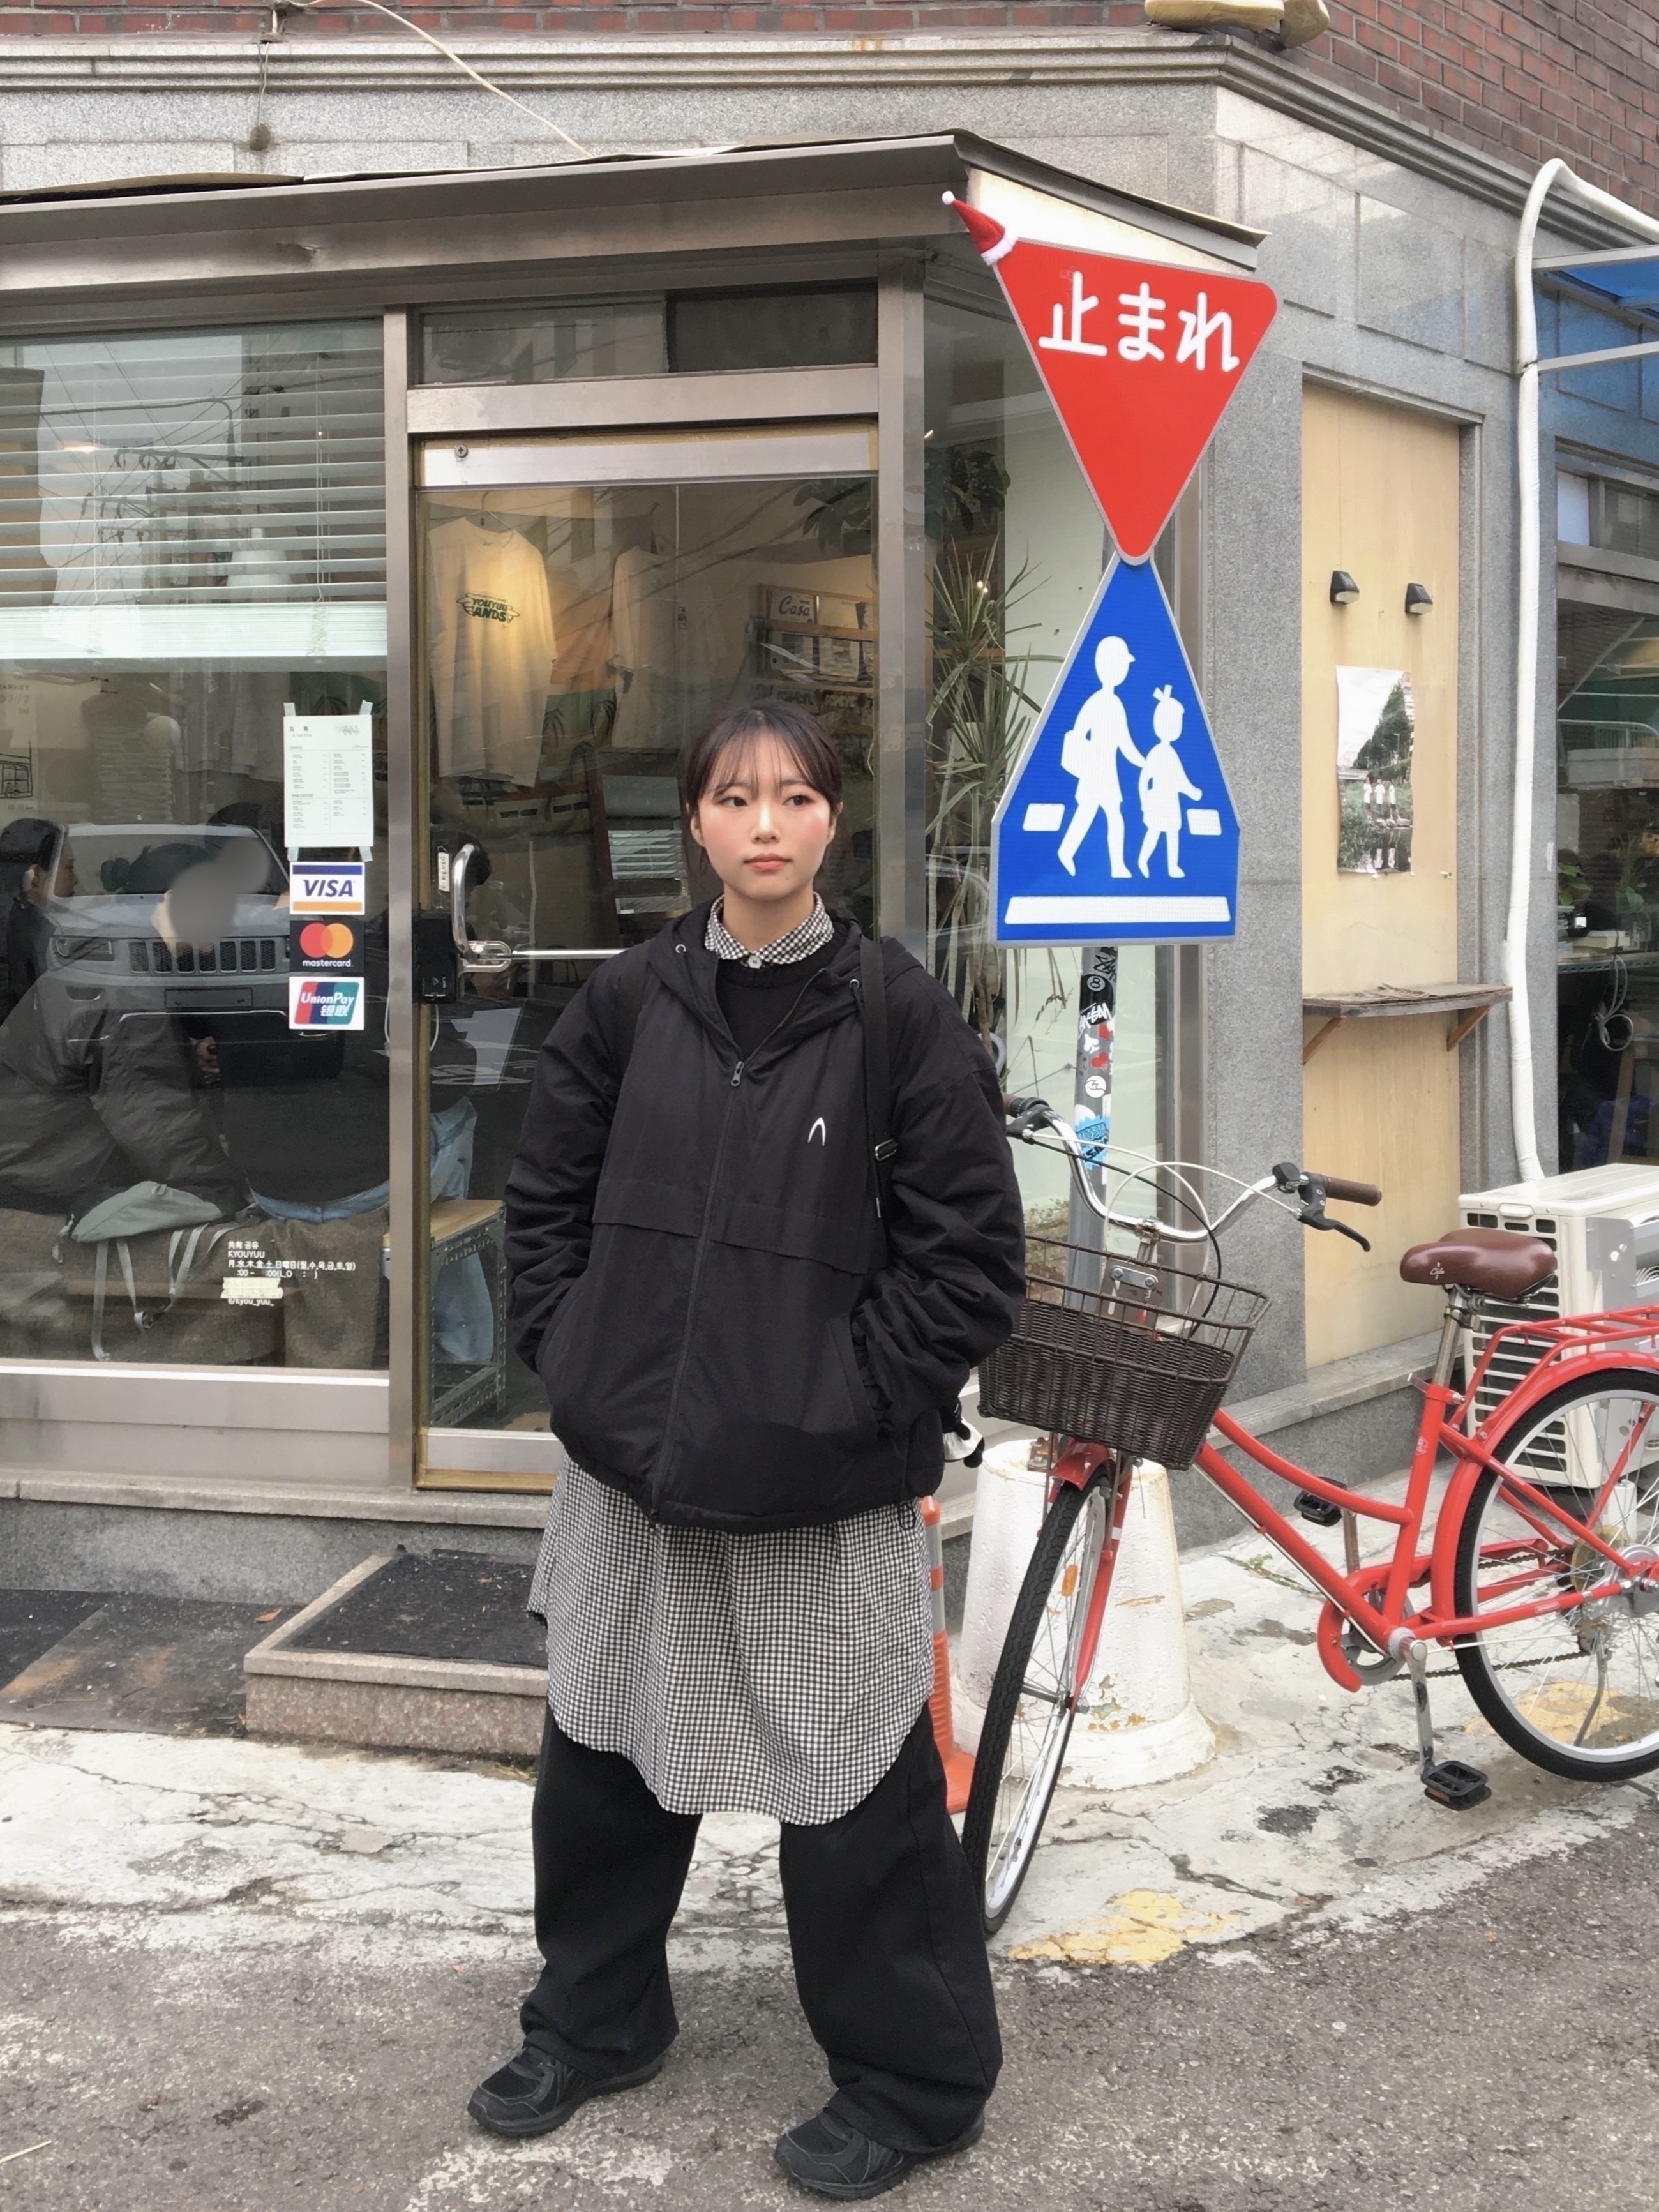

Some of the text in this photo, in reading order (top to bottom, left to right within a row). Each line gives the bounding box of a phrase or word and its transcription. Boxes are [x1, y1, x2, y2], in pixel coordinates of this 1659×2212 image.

[1038, 271, 1240, 372] 止まれ
[778, 596, 811, 617] Casa
[303, 880, 353, 897] VISA
[301, 992, 355, 1008] UnionPay
[320, 1005, 349, 1016] 银联
[244, 1241, 259, 1250] 공유
